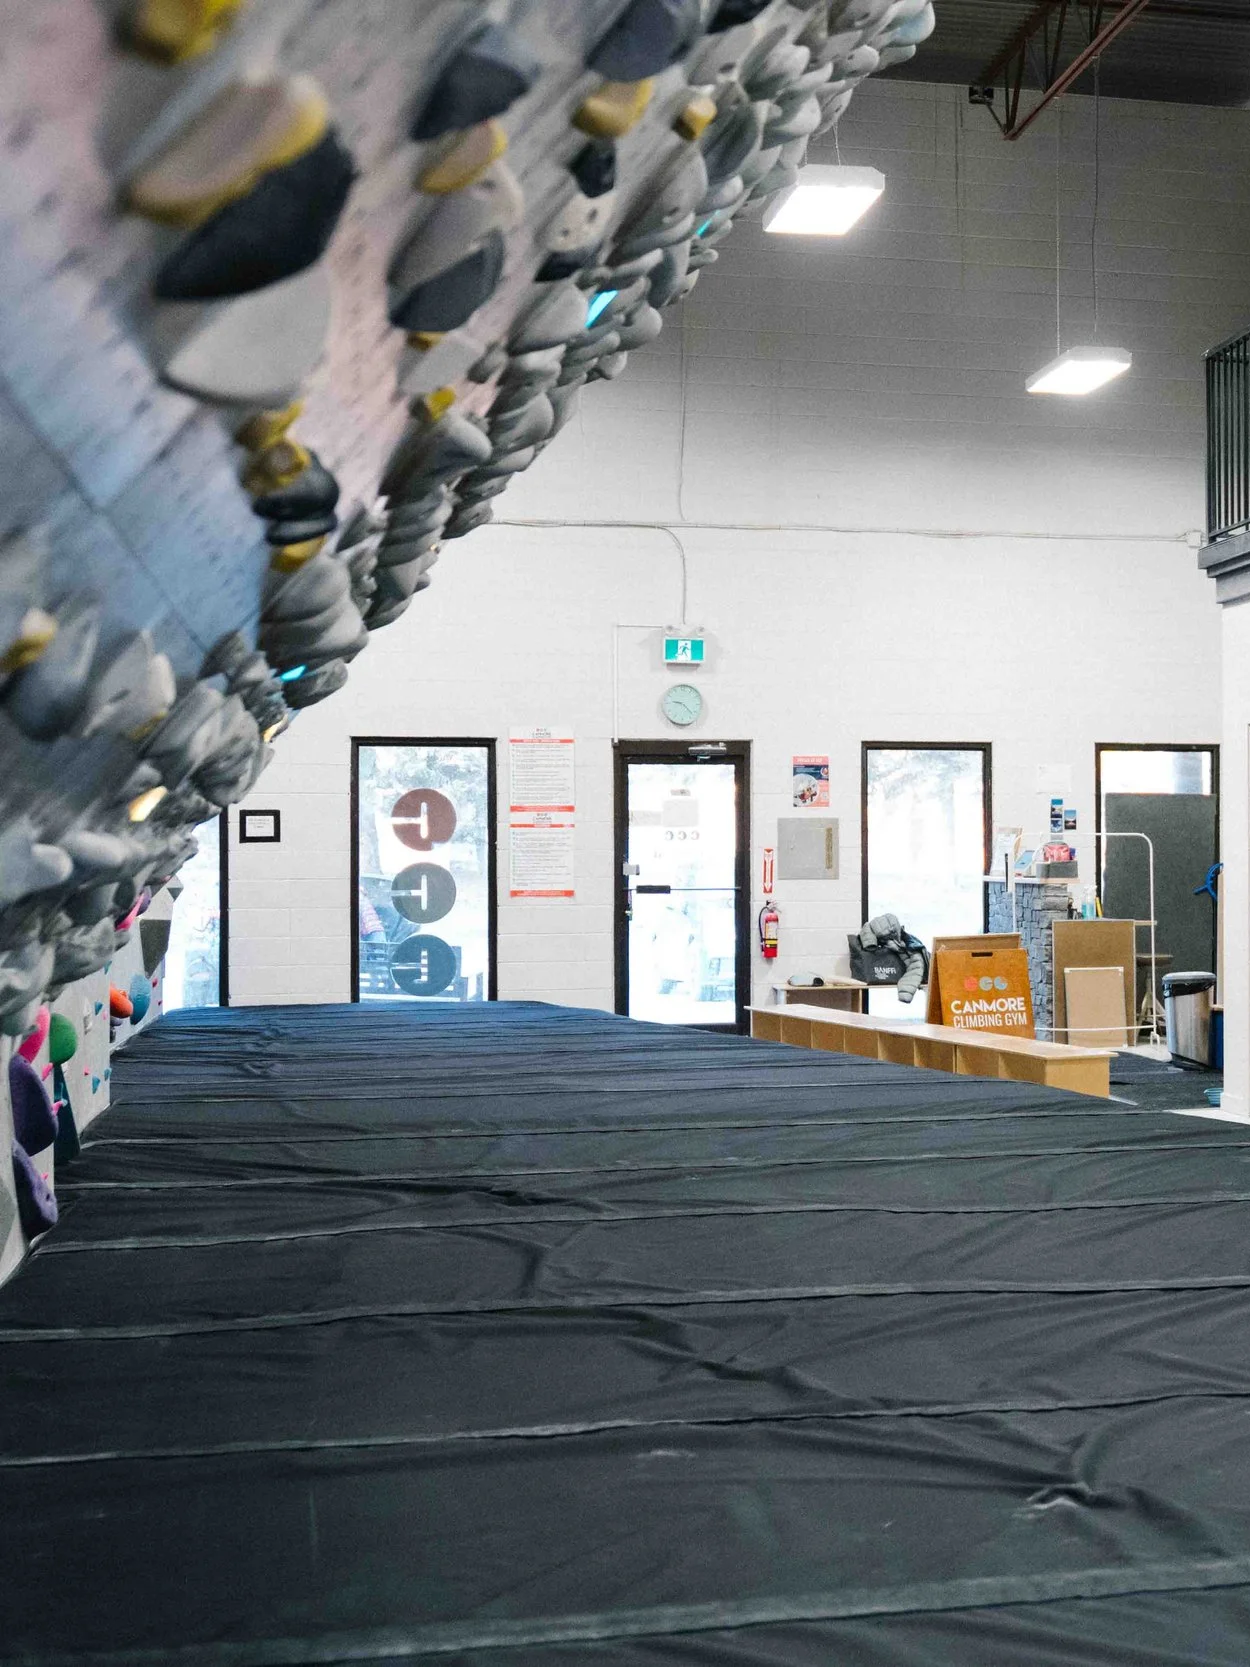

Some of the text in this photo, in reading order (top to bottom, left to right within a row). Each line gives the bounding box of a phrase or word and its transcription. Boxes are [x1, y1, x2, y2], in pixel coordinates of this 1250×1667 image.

[951, 997, 1026, 1014] CANMORE
[953, 1012, 1028, 1028] CLIMBING GYM
